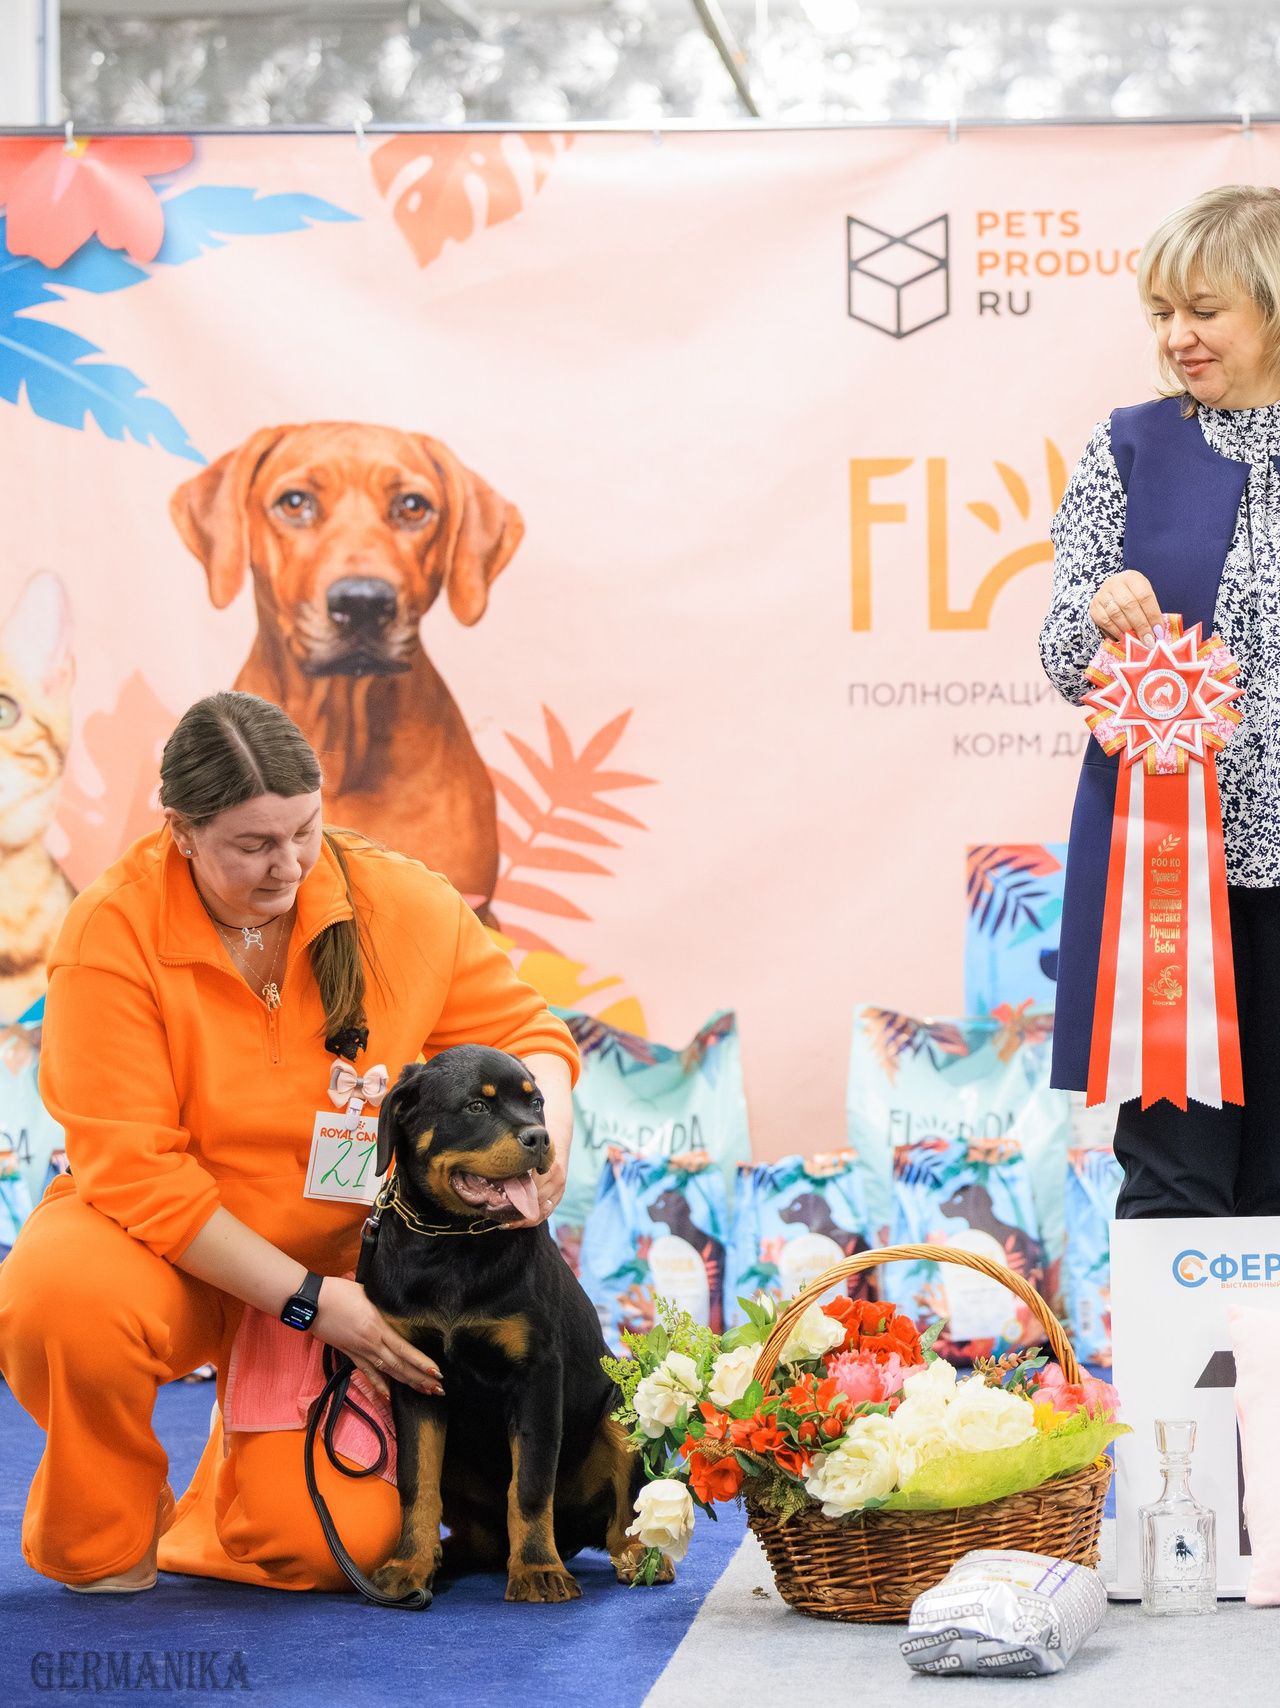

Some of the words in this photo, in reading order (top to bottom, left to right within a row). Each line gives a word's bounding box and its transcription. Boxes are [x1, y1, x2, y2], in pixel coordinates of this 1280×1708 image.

[977, 211, 1081, 238] PETS
[977, 249, 1141, 277] PRODUC
[978, 291, 1032, 316] RU
[848, 681, 1056, 707] ПОЛНОРАЦИ
[952, 732, 1041, 757] КОРМ
[1151, 858, 1168, 867] РОО
[1170, 858, 1181, 867] КО
[1150, 912, 1181, 923] выставка
[1149, 924, 1181, 940] Лучший
[1154, 938, 1176, 954] Беби
[320, 1127, 353, 1141] ROYAL
[356, 1131, 378, 1143] CAN
[320, 1140, 378, 1188] 21
[900, 1629, 962, 1655] ОМЕНЮ
[977, 1649, 1034, 1669] ОМЕНЮ
